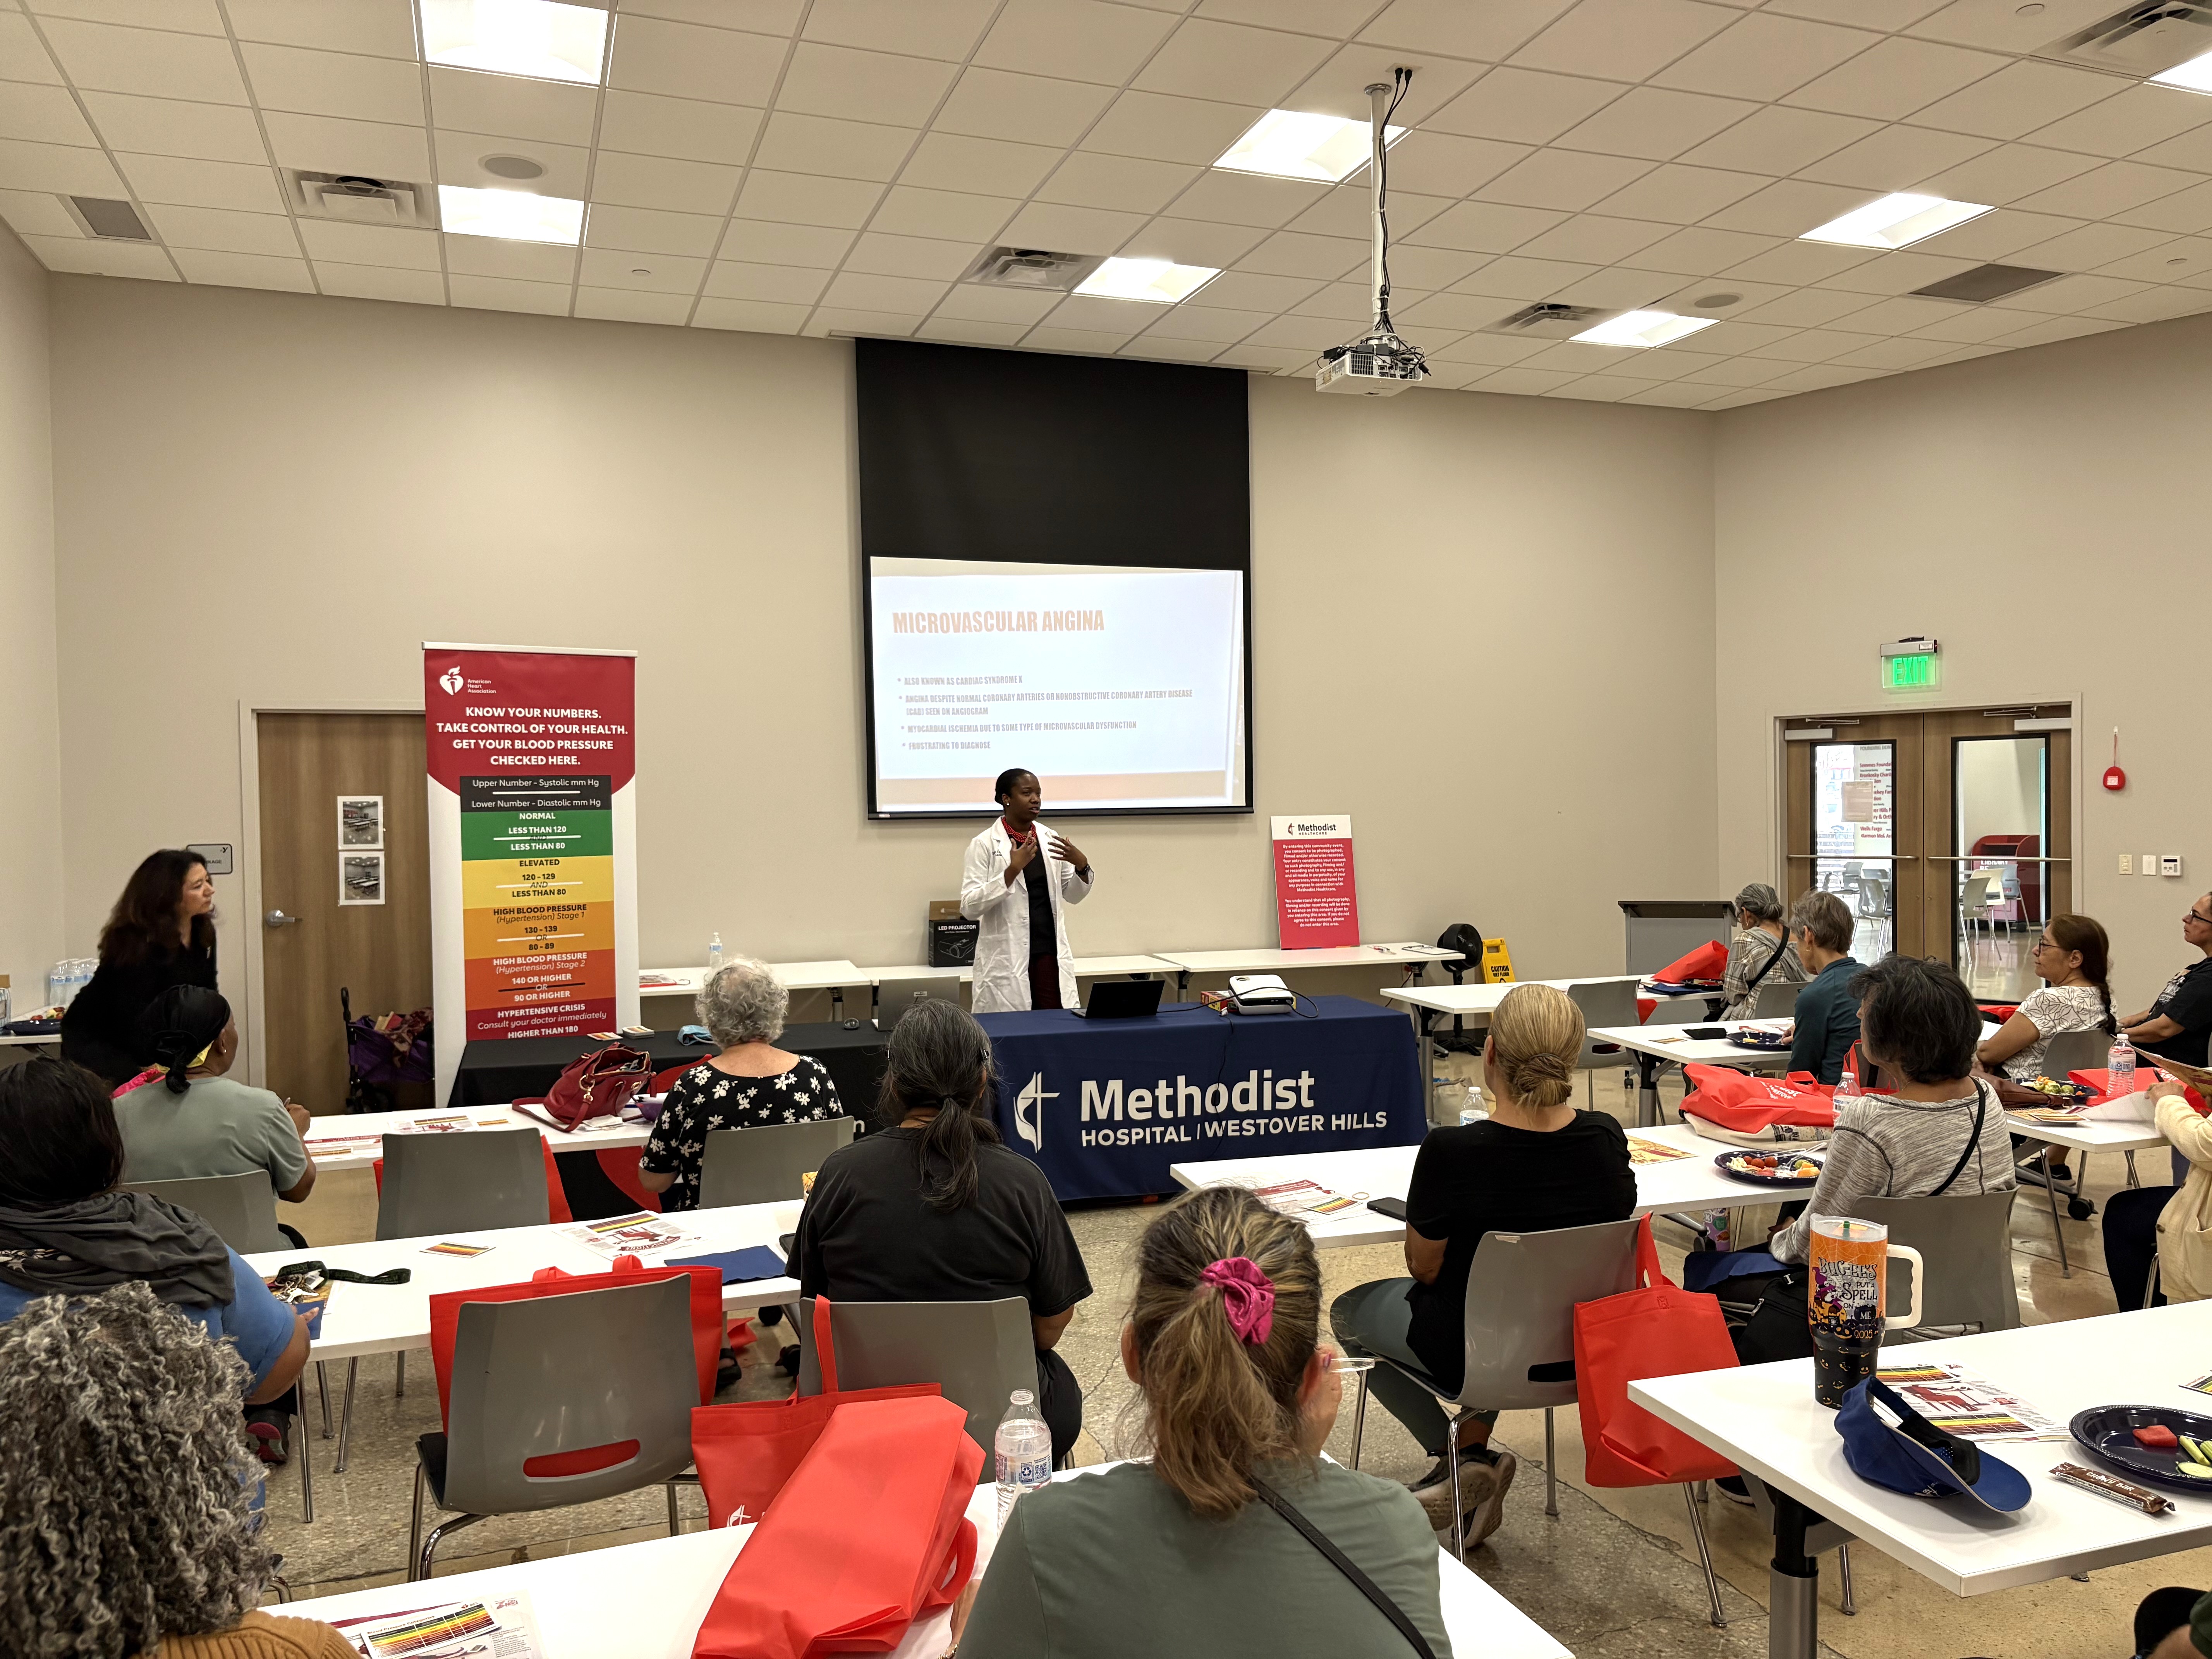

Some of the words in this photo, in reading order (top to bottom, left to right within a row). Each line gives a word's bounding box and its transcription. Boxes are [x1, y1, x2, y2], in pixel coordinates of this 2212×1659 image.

[892, 611, 1038, 634] MICROVASCULAR
[1042, 610, 1104, 631] ANGINA
[1892, 656, 1929, 685] EXIT
[904, 677, 919, 685] ALSO
[946, 677, 955, 685] AS
[956, 676, 982, 684] CARDIAC
[984, 675, 1018, 684] SYNDROME
[930, 694, 955, 702] DESPITE
[957, 694, 981, 702] NORMAL
[983, 693, 1015, 701] CORONARY
[1017, 692, 1045, 701] ARTERIES
[1046, 692, 1054, 700] OR
[1056, 691, 1109, 700] NONOBSTRUCTIVE
[1111, 690, 1143, 699] CORONARY
[1144, 690, 1167, 698] ARTERY
[1168, 689, 1192, 697] DISEASE
[466, 708, 505, 717] KNOW
[508, 708, 541, 717] YOUR
[544, 709, 601, 718] NUMBERS.
[926, 708, 939, 716] SEEN
[941, 707, 950, 715] ON
[951, 707, 988, 715] ANGIOGRAM
[437, 723, 468, 732] TAKE
[471, 724, 527, 733] CONTROL
[530, 724, 545, 733] OF
[548, 725, 579, 734] YOUR
[582, 725, 628, 734] HEALTH.
[908, 724, 947, 733] MYOCARDIAL
[948, 724, 978, 732] ISCHEMIA
[980, 723, 991, 732] DUE
[993, 723, 1001, 732] TO
[1002, 723, 1018, 731] SOME
[1019, 722, 1034, 731] TYPE
[1035, 722, 1042, 730] OF
[1044, 721, 1094, 730] MICROVASCULAR
[1096, 721, 1137, 729] DYSFUNCTION
[453, 740, 476, 749] GET
[478, 740, 512, 749] YOUR
[515, 740, 555, 749] BLOOD
[558, 741, 613, 749] PRESSURE
[908, 742, 949, 750] FRUSTRATING
[951, 741, 959, 750] TO
[960, 740, 991, 749] DIAGNOSE
[491, 756, 546, 765] CHECKED
[549, 756, 580, 765] HERE.
[539, 779, 568, 787] Systolic
[547, 904, 587, 913] PRESSURE
[496, 914, 555, 924] (Hypertension)
[517, 955, 545, 963] BLOOD
[547, 953, 587, 961] PRESSURE
[496, 963, 555, 974] (Hypertension)
[539, 991, 570, 999] HIGHER
[498, 1006, 558, 1018] HYPERTENSIVE
[478, 1020, 509, 1029] Consult
[511, 1020, 529, 1029] your
[531, 1016, 556, 1025] doctor
[558, 1012, 607, 1022] immediately
[508, 1030, 540, 1038] HIGHER
[541, 1027, 563, 1036] THAN
[1081, 1069, 1315, 1121] Methodist
[1082, 1125, 1192, 1147] HOSPITAL
[1204, 1115, 1324, 1138] WESTOVER
[1330, 1111, 1387, 1131] HILLS
[1840, 1283, 1877, 1303] SPELL
[1854, 1330, 1872, 1338] 2025
